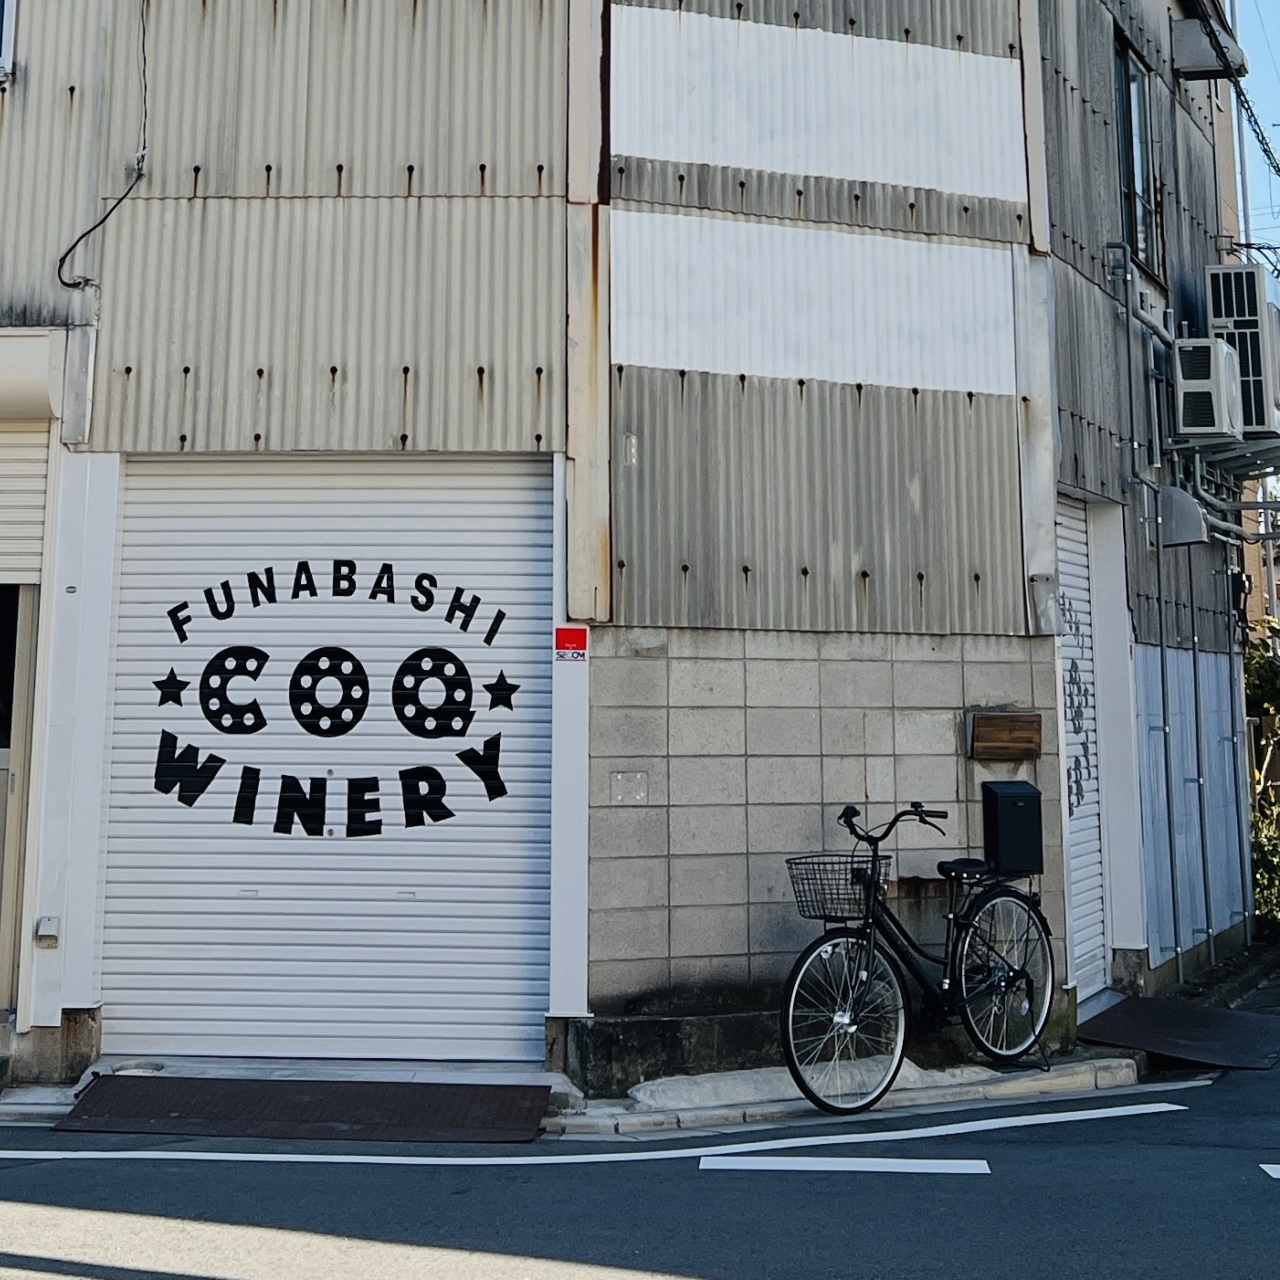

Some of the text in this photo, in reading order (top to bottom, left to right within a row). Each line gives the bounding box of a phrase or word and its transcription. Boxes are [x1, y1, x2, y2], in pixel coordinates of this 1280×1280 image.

[166, 559, 507, 646] FUNABASHI
[198, 646, 477, 739] COQ
[152, 729, 508, 838] WINERY
